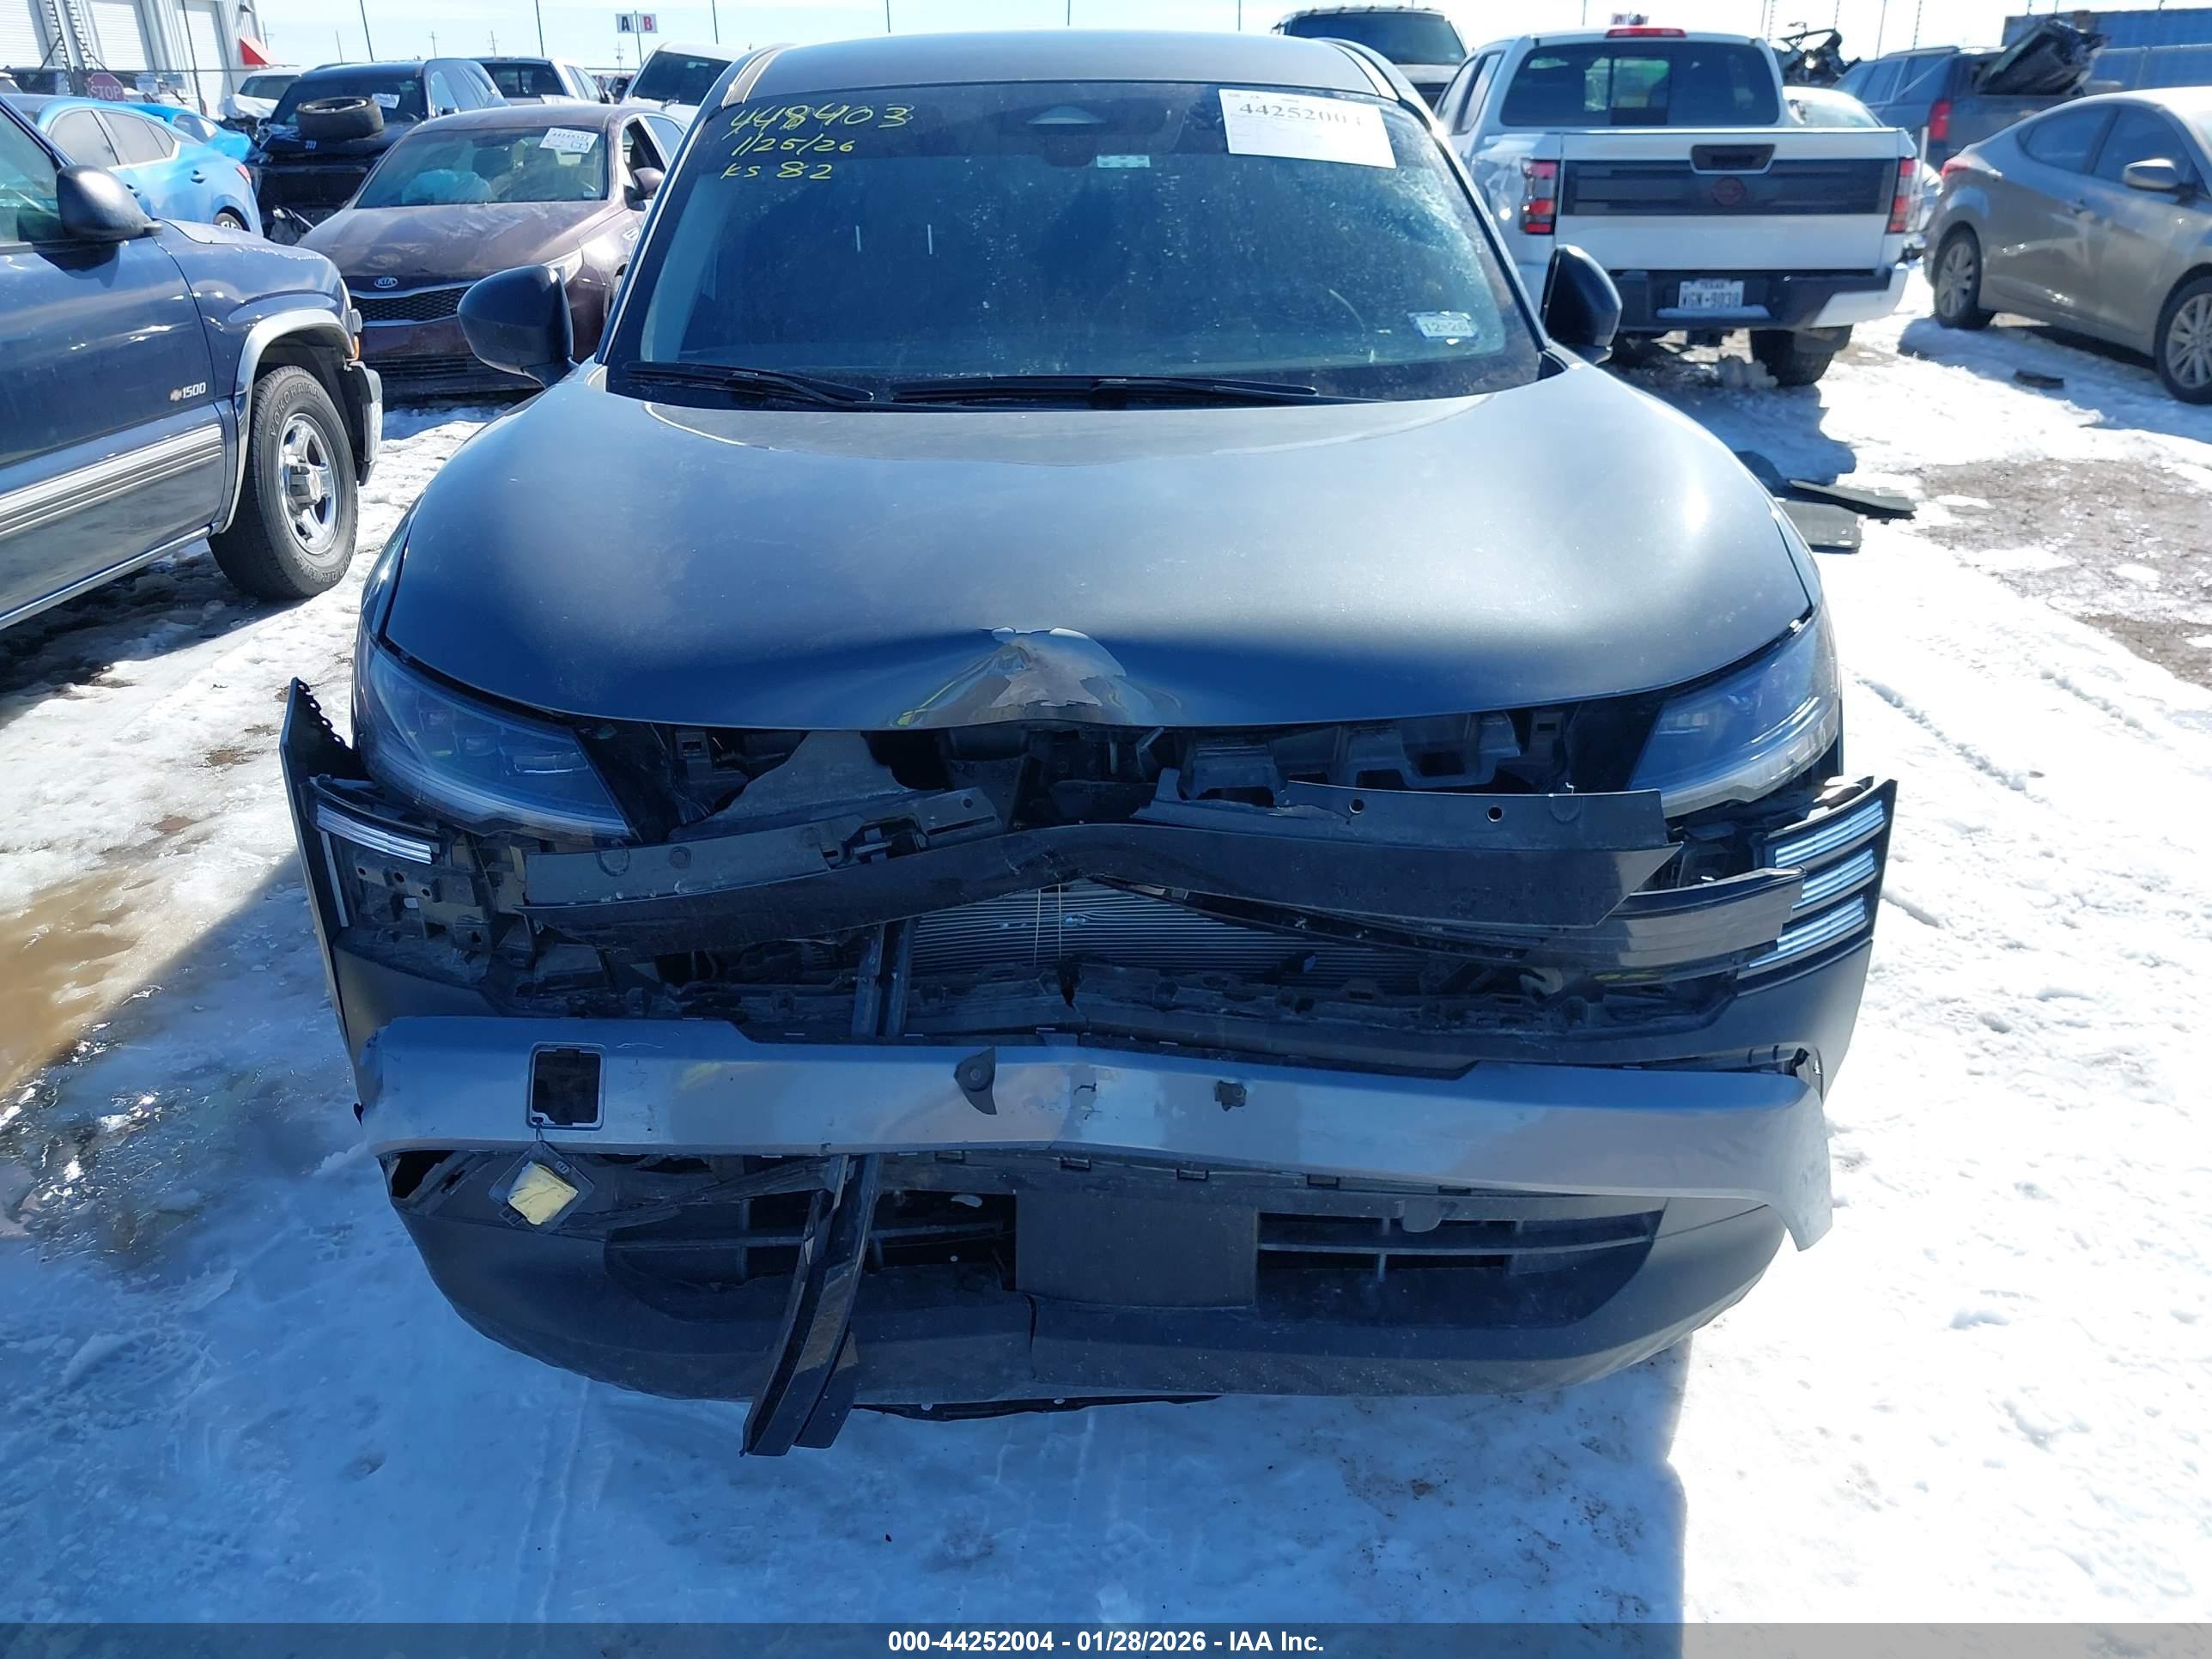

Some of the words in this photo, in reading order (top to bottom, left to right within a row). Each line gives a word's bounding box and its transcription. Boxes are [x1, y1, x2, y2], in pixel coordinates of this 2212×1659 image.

[621, 15, 630, 32] A
[643, 15, 653, 31] B
[89, 86, 121, 100] STOP
[721, 102, 915, 140] 448403
[732, 132, 856, 156] 1/25/26
[776, 161, 833, 179] 82
[376, 276, 397, 286] KIA
[182, 381, 207, 399] 1500
